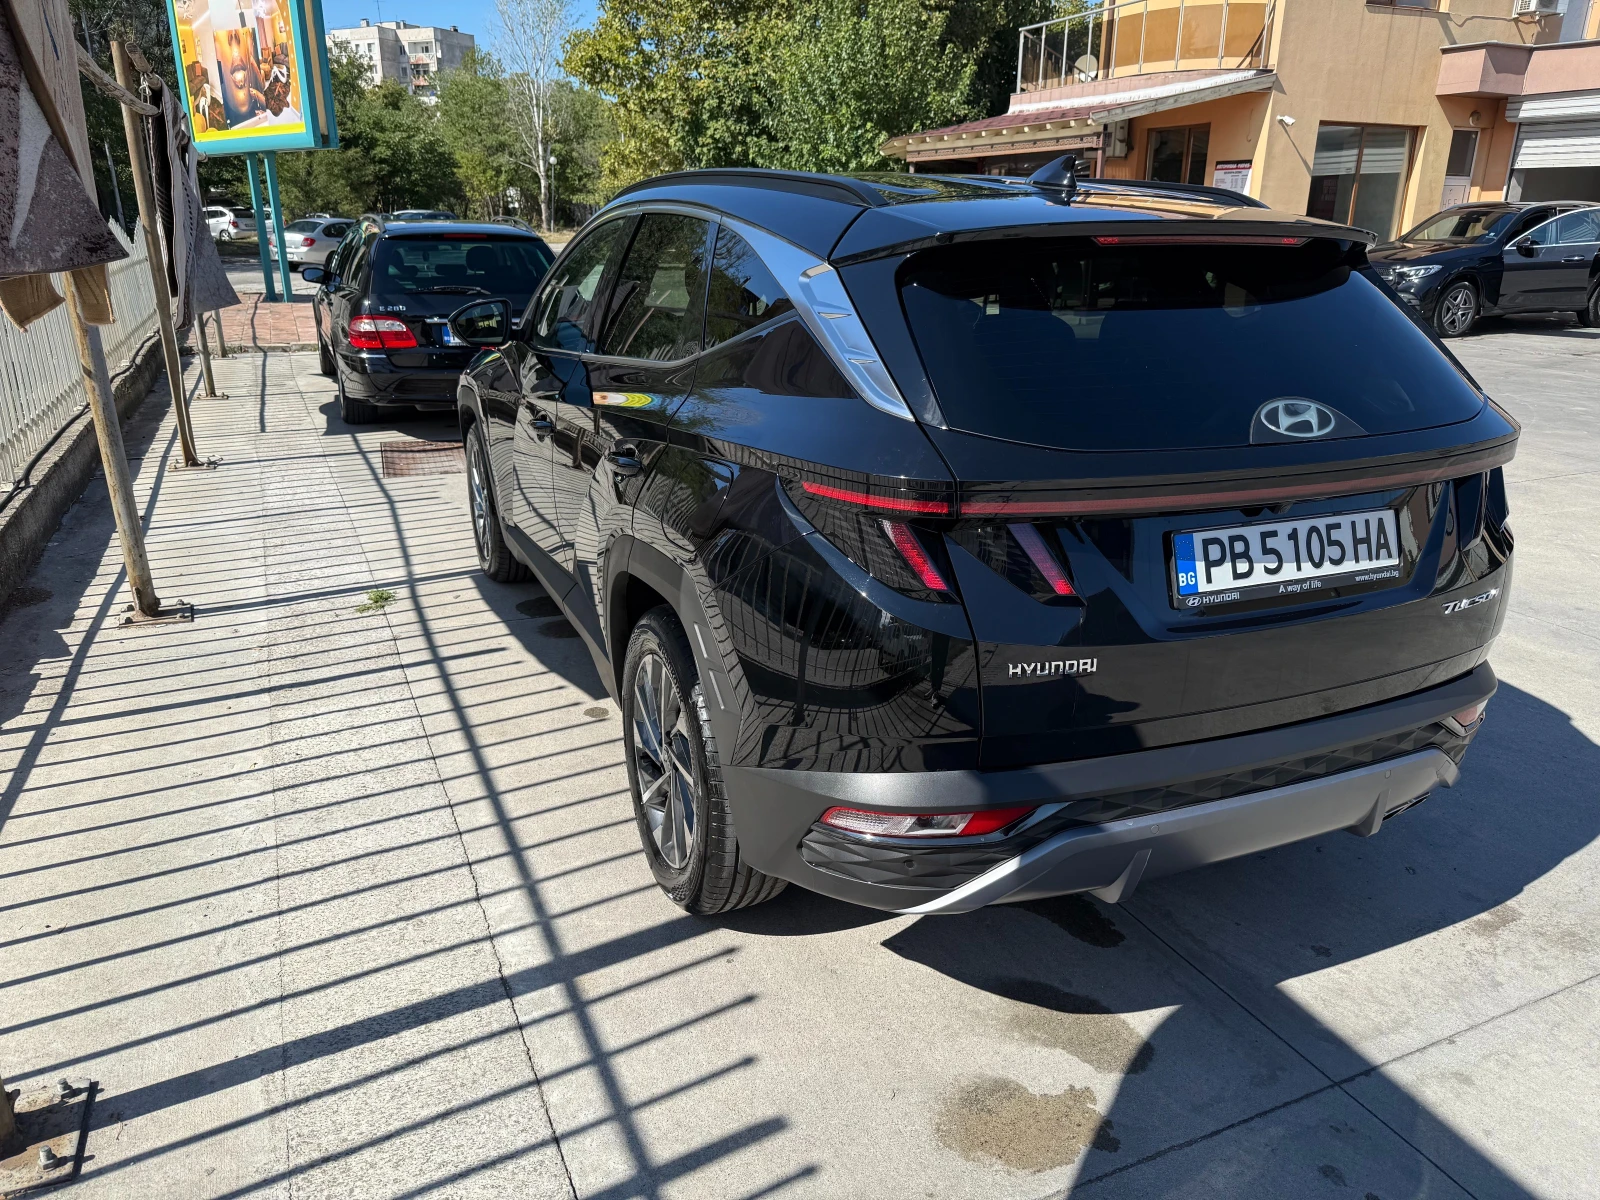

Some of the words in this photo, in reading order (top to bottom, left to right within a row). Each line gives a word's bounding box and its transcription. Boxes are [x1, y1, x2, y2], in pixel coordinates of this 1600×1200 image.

[1202, 534, 1255, 585] PB
[1259, 522, 1346, 577] 5105
[1350, 517, 1393, 565] HA
[1179, 571, 1196, 587] BG
[1279, 584, 1286, 593] A
[1286, 583, 1301, 593] way
[1302, 580, 1310, 590] of
[1310, 579, 1322, 589] life
[1201, 591, 1241, 604] HYUNDAI
[1008, 658, 1098, 678] HYUNDAI
